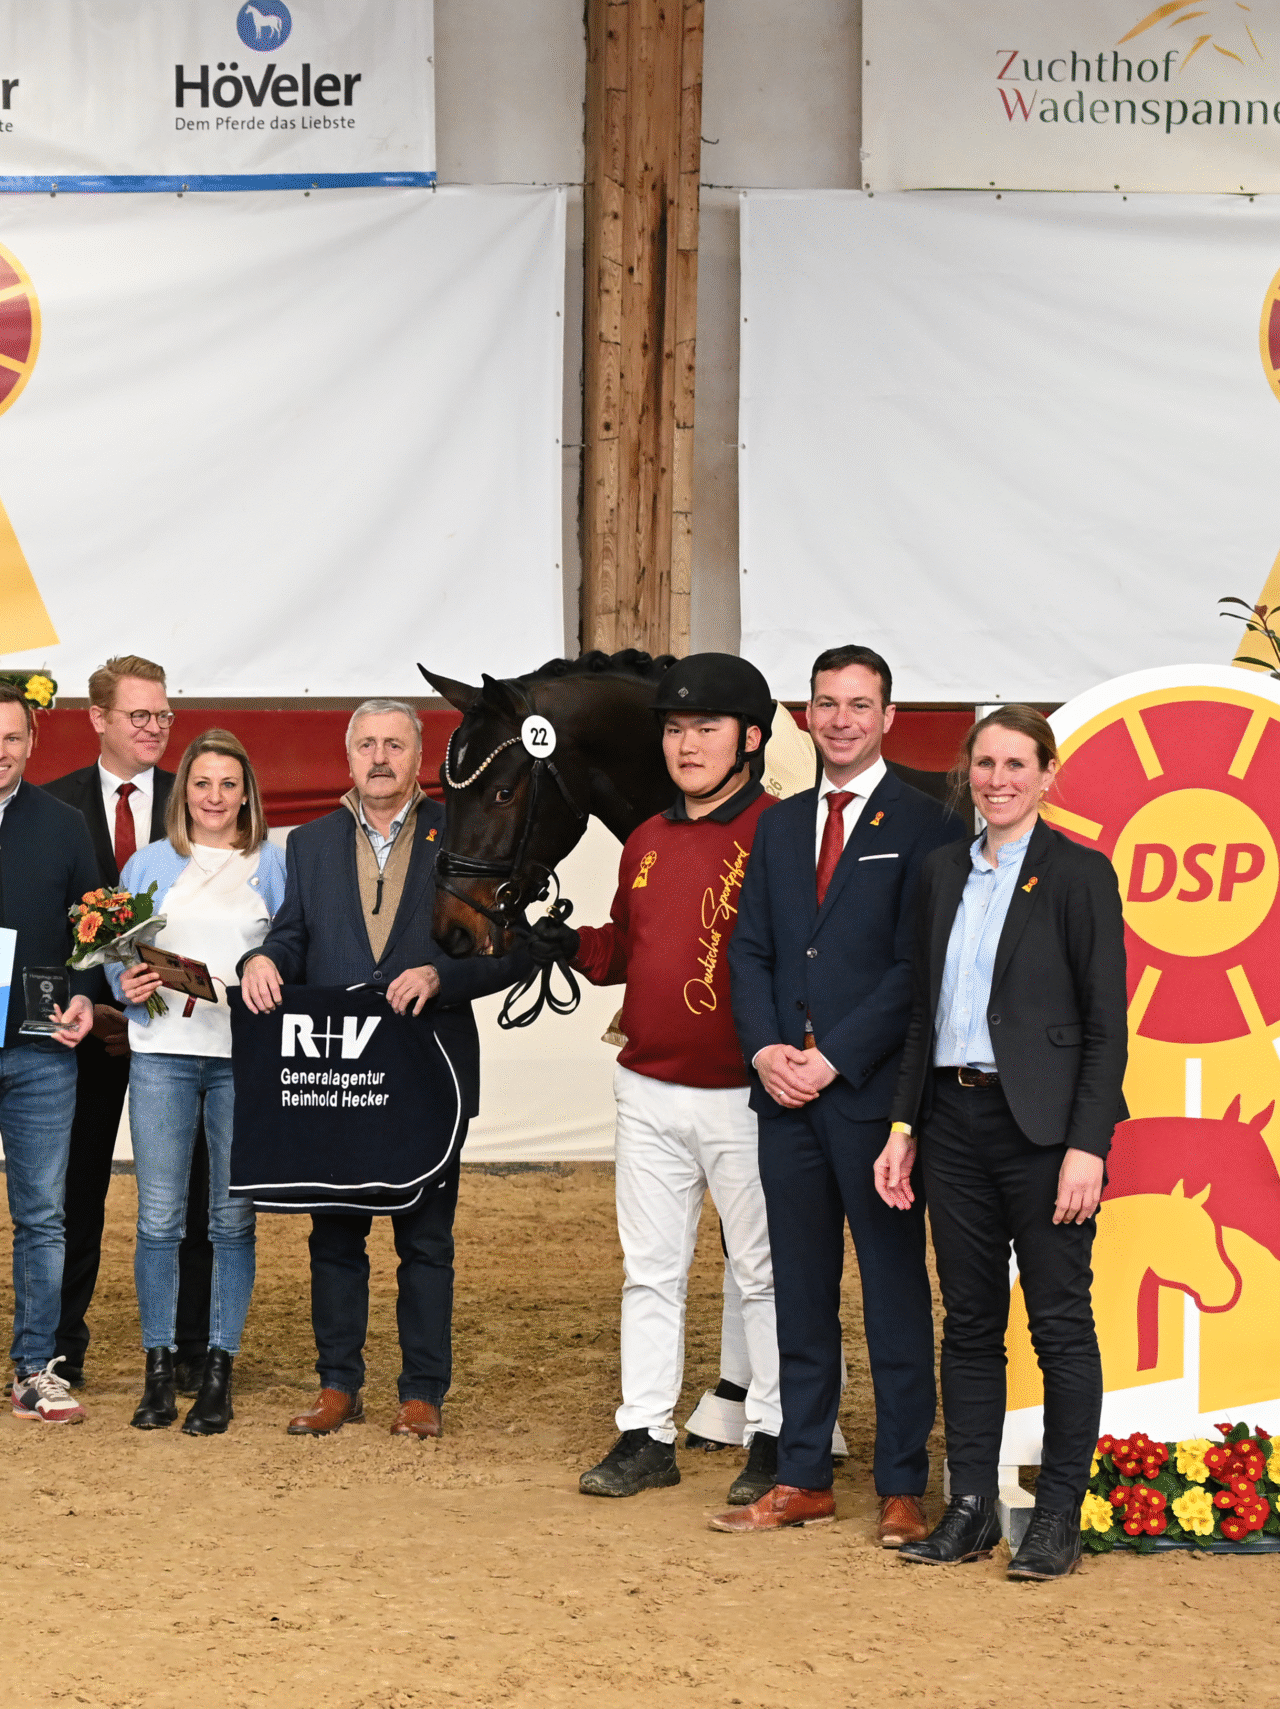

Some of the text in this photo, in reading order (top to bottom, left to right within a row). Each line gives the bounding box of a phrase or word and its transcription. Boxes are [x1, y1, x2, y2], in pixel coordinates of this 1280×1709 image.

[996, 50, 1179, 83] Zuchthof
[175, 115, 356, 131] Dem Pferde das Liebste
[530, 727, 549, 746] 22
[1126, 842, 1266, 903] DSP
[281, 1013, 382, 1060] R+V
[281, 1068, 385, 1089] Generalagentur
[281, 1089, 390, 1108] Reinhold Hecker
